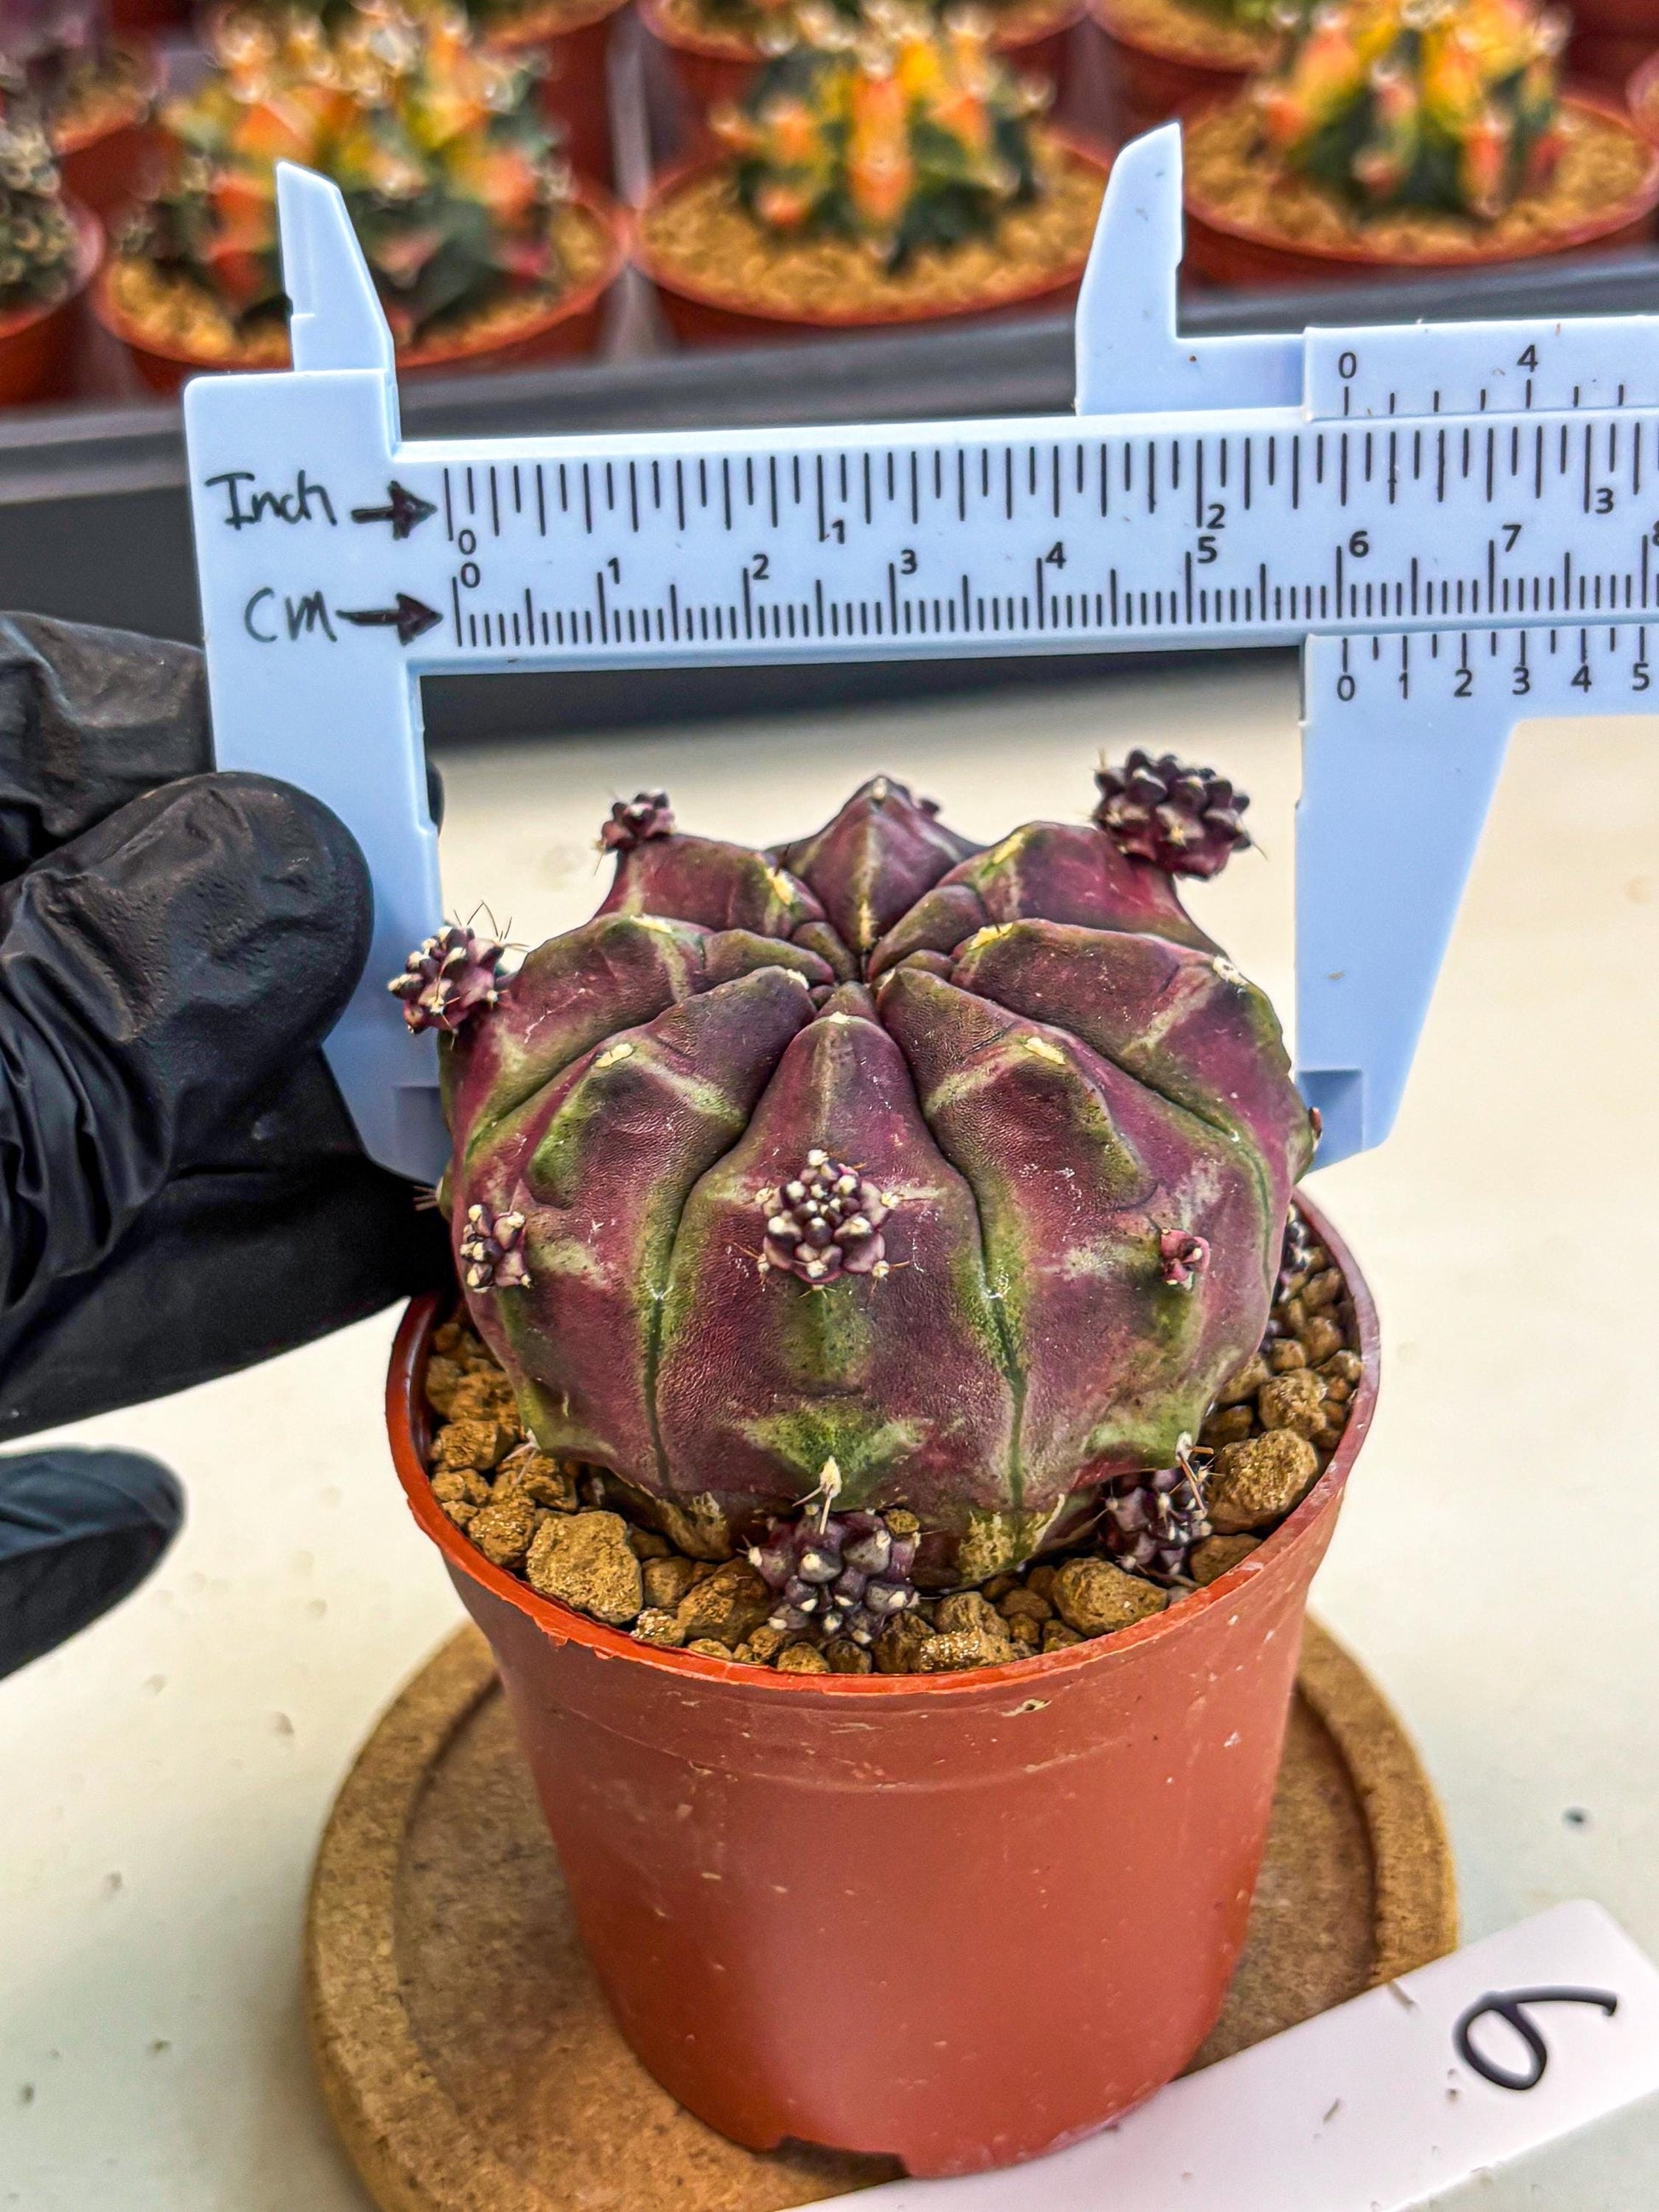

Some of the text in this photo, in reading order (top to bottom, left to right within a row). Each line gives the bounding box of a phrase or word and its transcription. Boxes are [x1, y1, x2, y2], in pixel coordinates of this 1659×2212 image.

[1338, 344, 1539, 379] 0 4
[204, 469, 338, 532] Inch
[457, 487, 1615, 556] 0 1 2 3
[460, 523, 1523, 589] 0 1 2 3 4 5 6 7
[1336, 663, 1650, 702] 0 1 2 3 4 5
